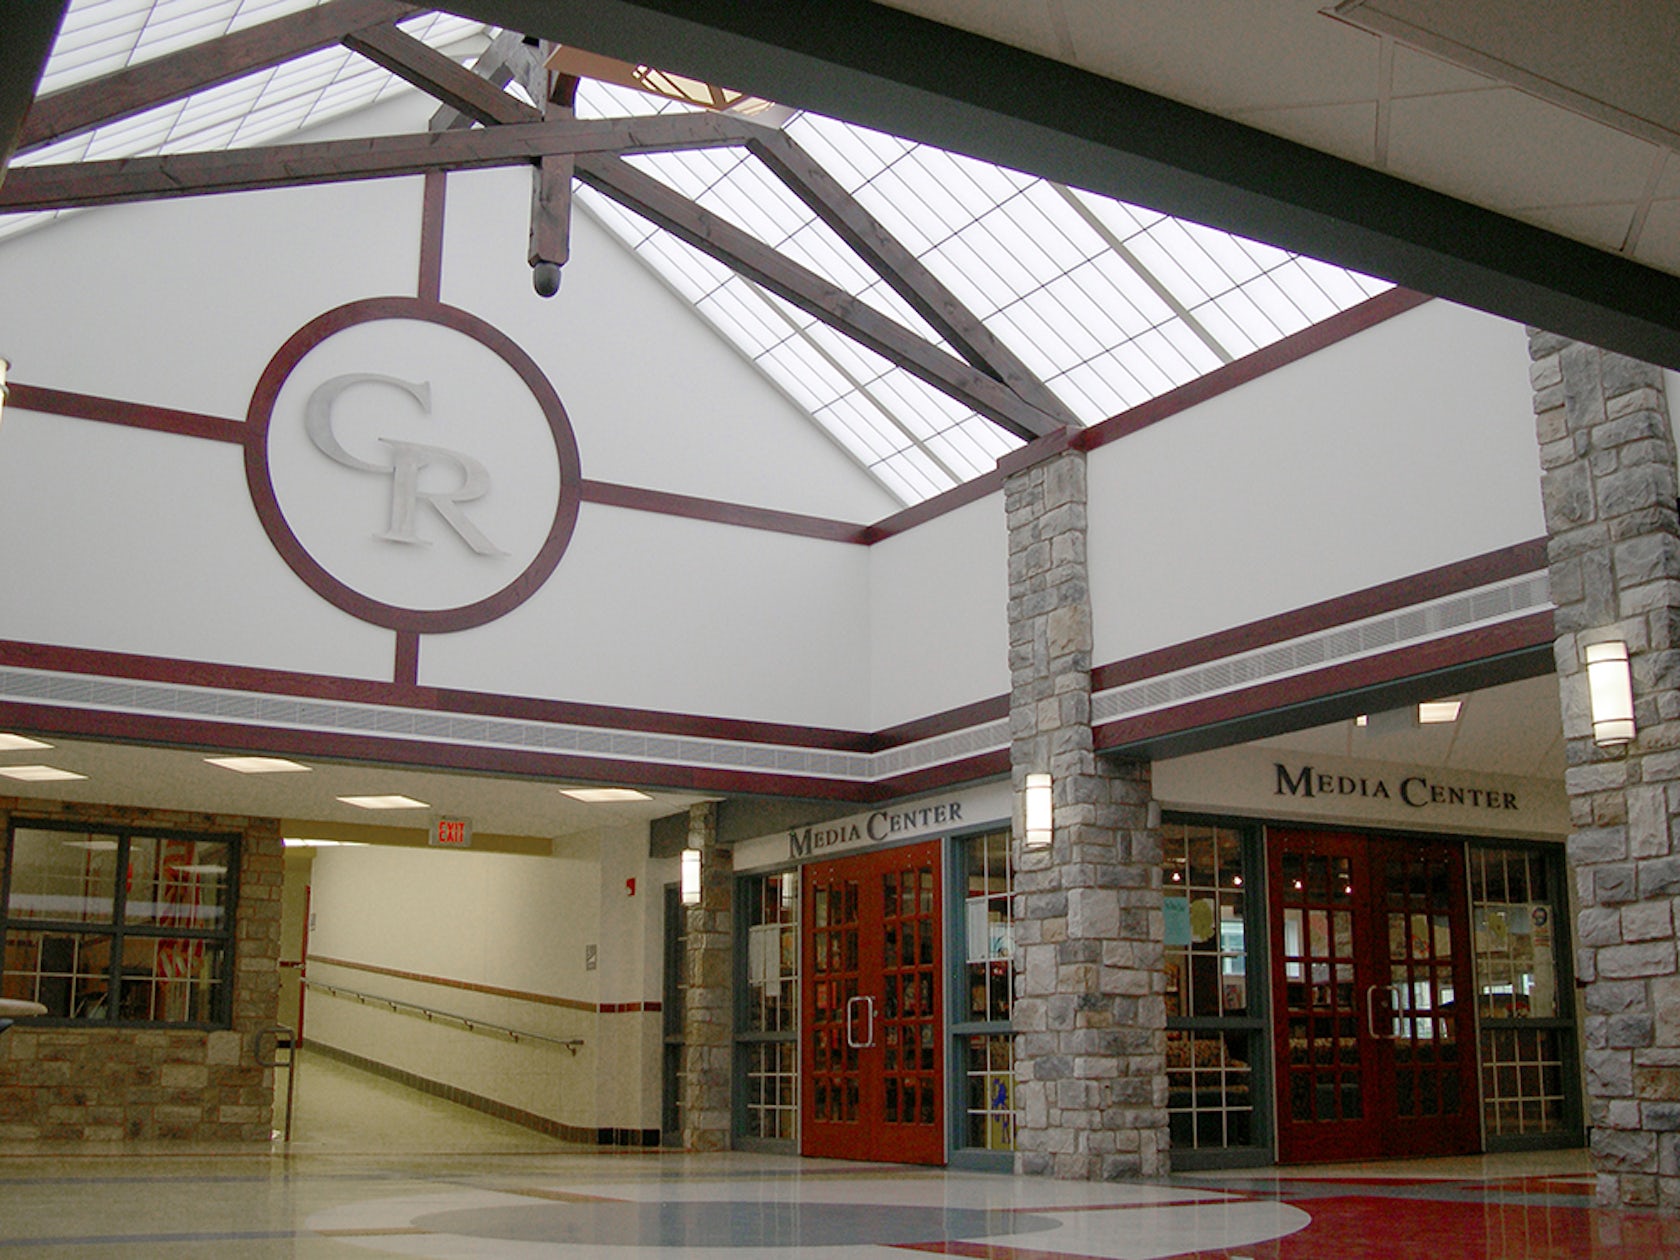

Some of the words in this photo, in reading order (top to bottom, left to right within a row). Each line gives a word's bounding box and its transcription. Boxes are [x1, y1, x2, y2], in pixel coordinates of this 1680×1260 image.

[1274, 763, 1391, 798] MEDIA
[1401, 776, 1519, 810] CENTER
[438, 820, 465, 843] EXIT
[789, 824, 861, 859] MEDIA
[867, 802, 963, 841] CENTER
